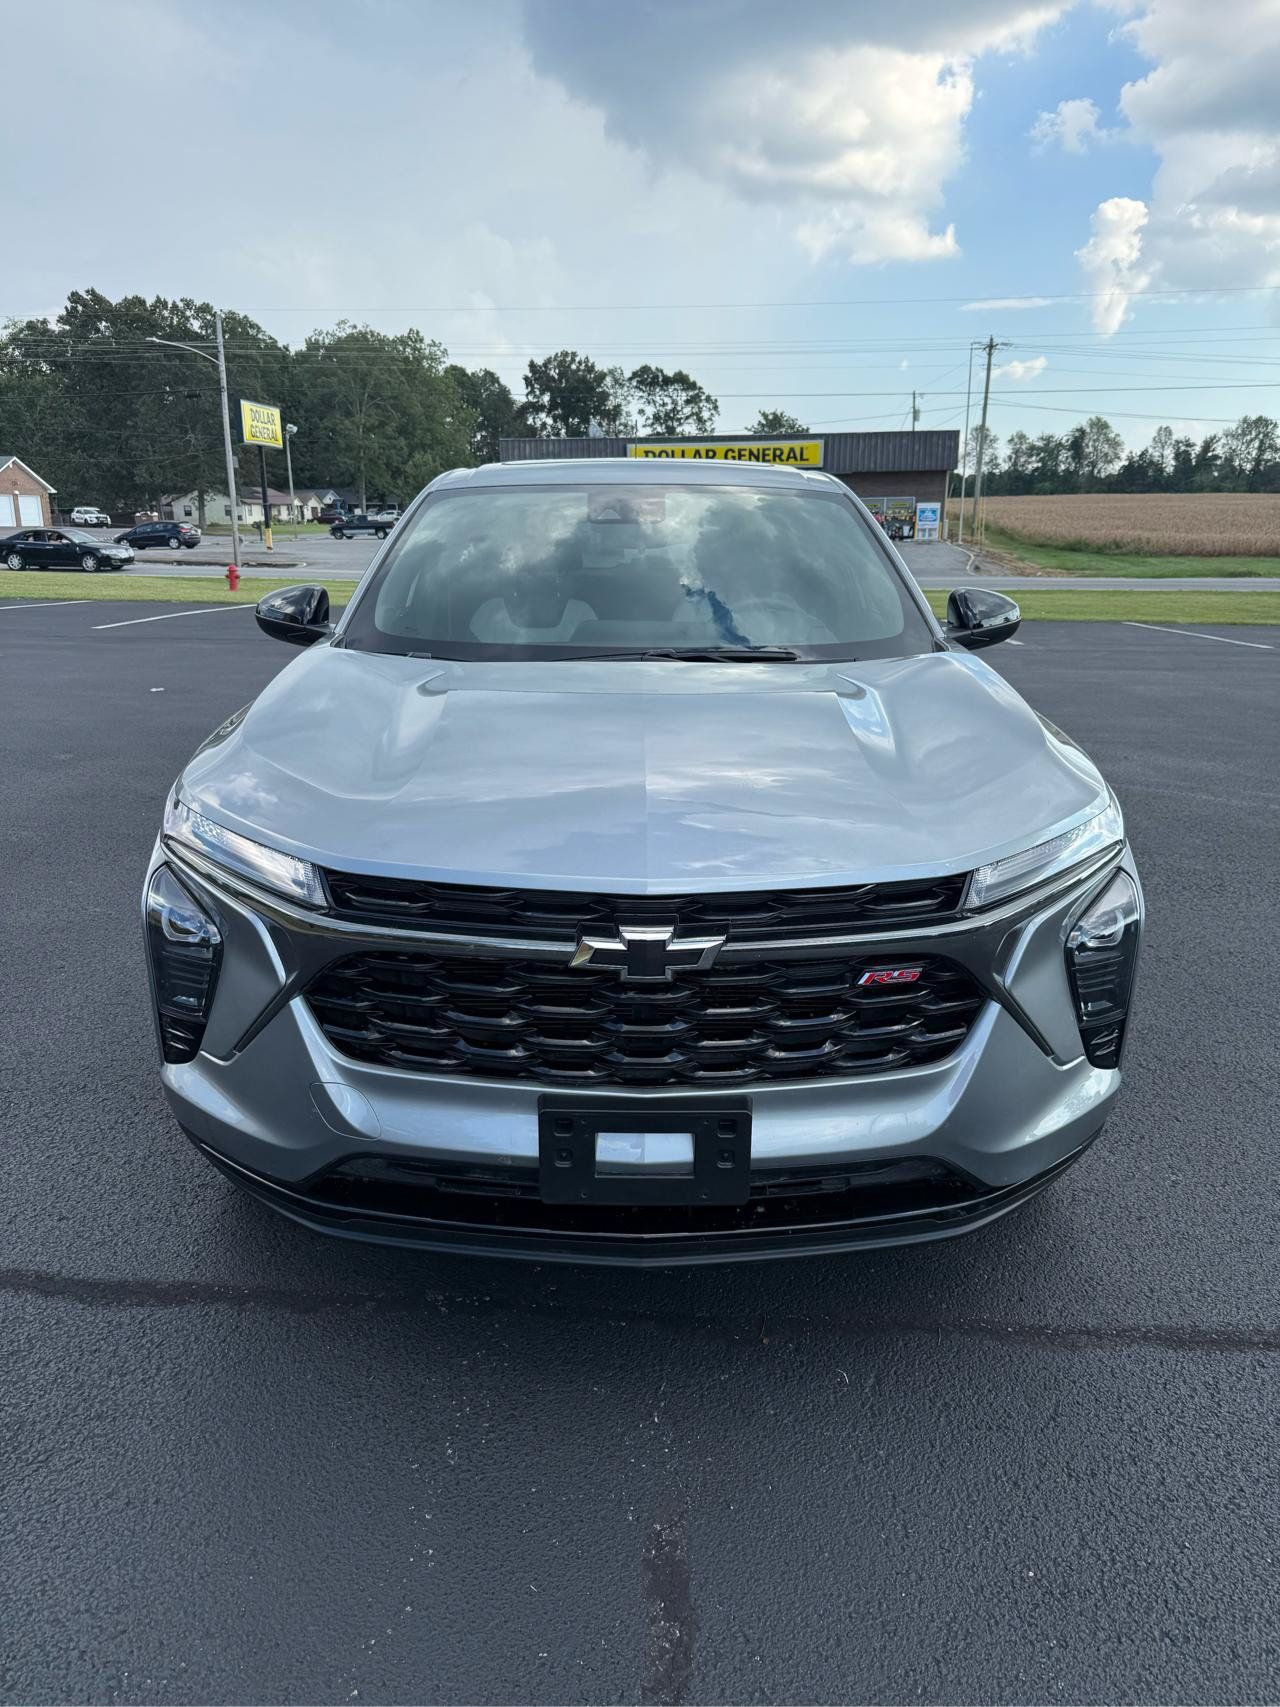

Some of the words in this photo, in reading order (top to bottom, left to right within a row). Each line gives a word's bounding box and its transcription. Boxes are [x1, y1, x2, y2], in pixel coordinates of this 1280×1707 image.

[250, 408, 276, 426] DOLLAR
[250, 424, 278, 441] GENERAL
[724, 446, 810, 463] GENERAL
[857, 968, 921, 985] RS
